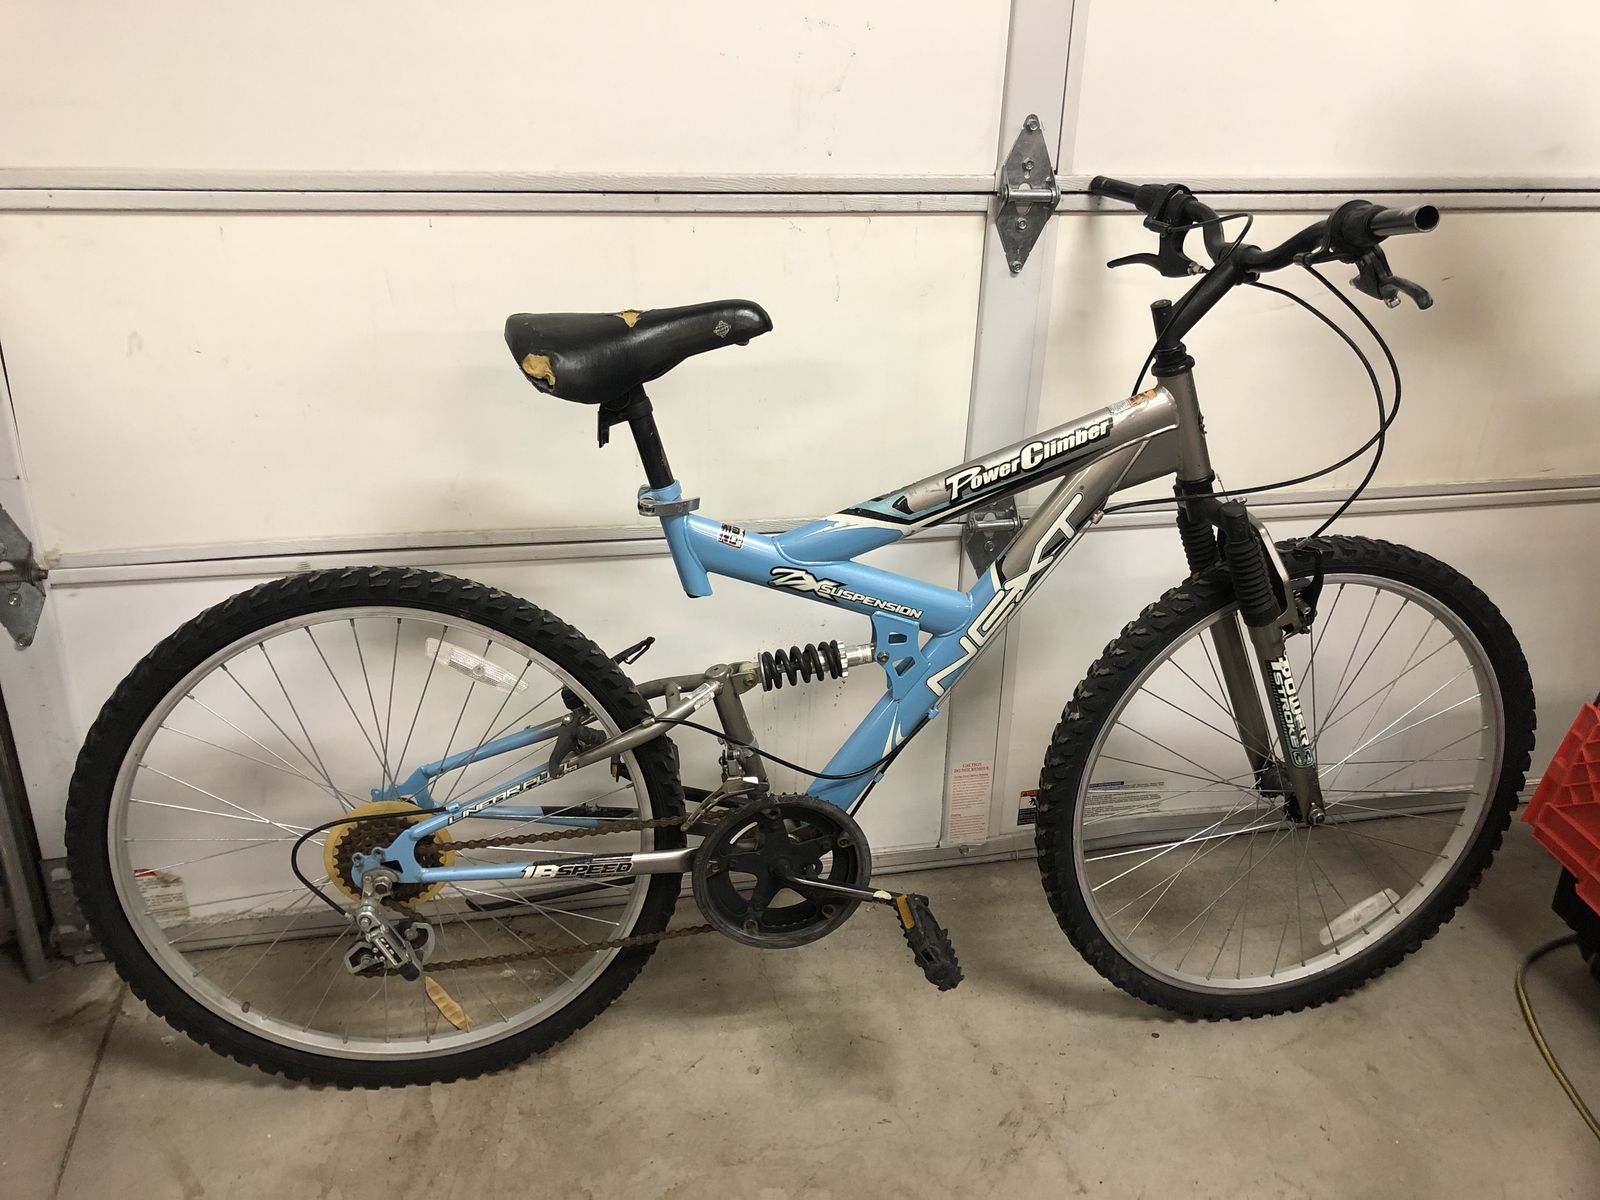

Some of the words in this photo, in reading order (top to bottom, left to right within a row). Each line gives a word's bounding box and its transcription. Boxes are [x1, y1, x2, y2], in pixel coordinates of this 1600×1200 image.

[819, 583, 922, 620] SUSPENSION
[926, 492, 1083, 697] NEXT
[1270, 655, 1310, 747] POWER
[1273, 671, 1300, 748] STROKE
[555, 862, 632, 876] SPEED
